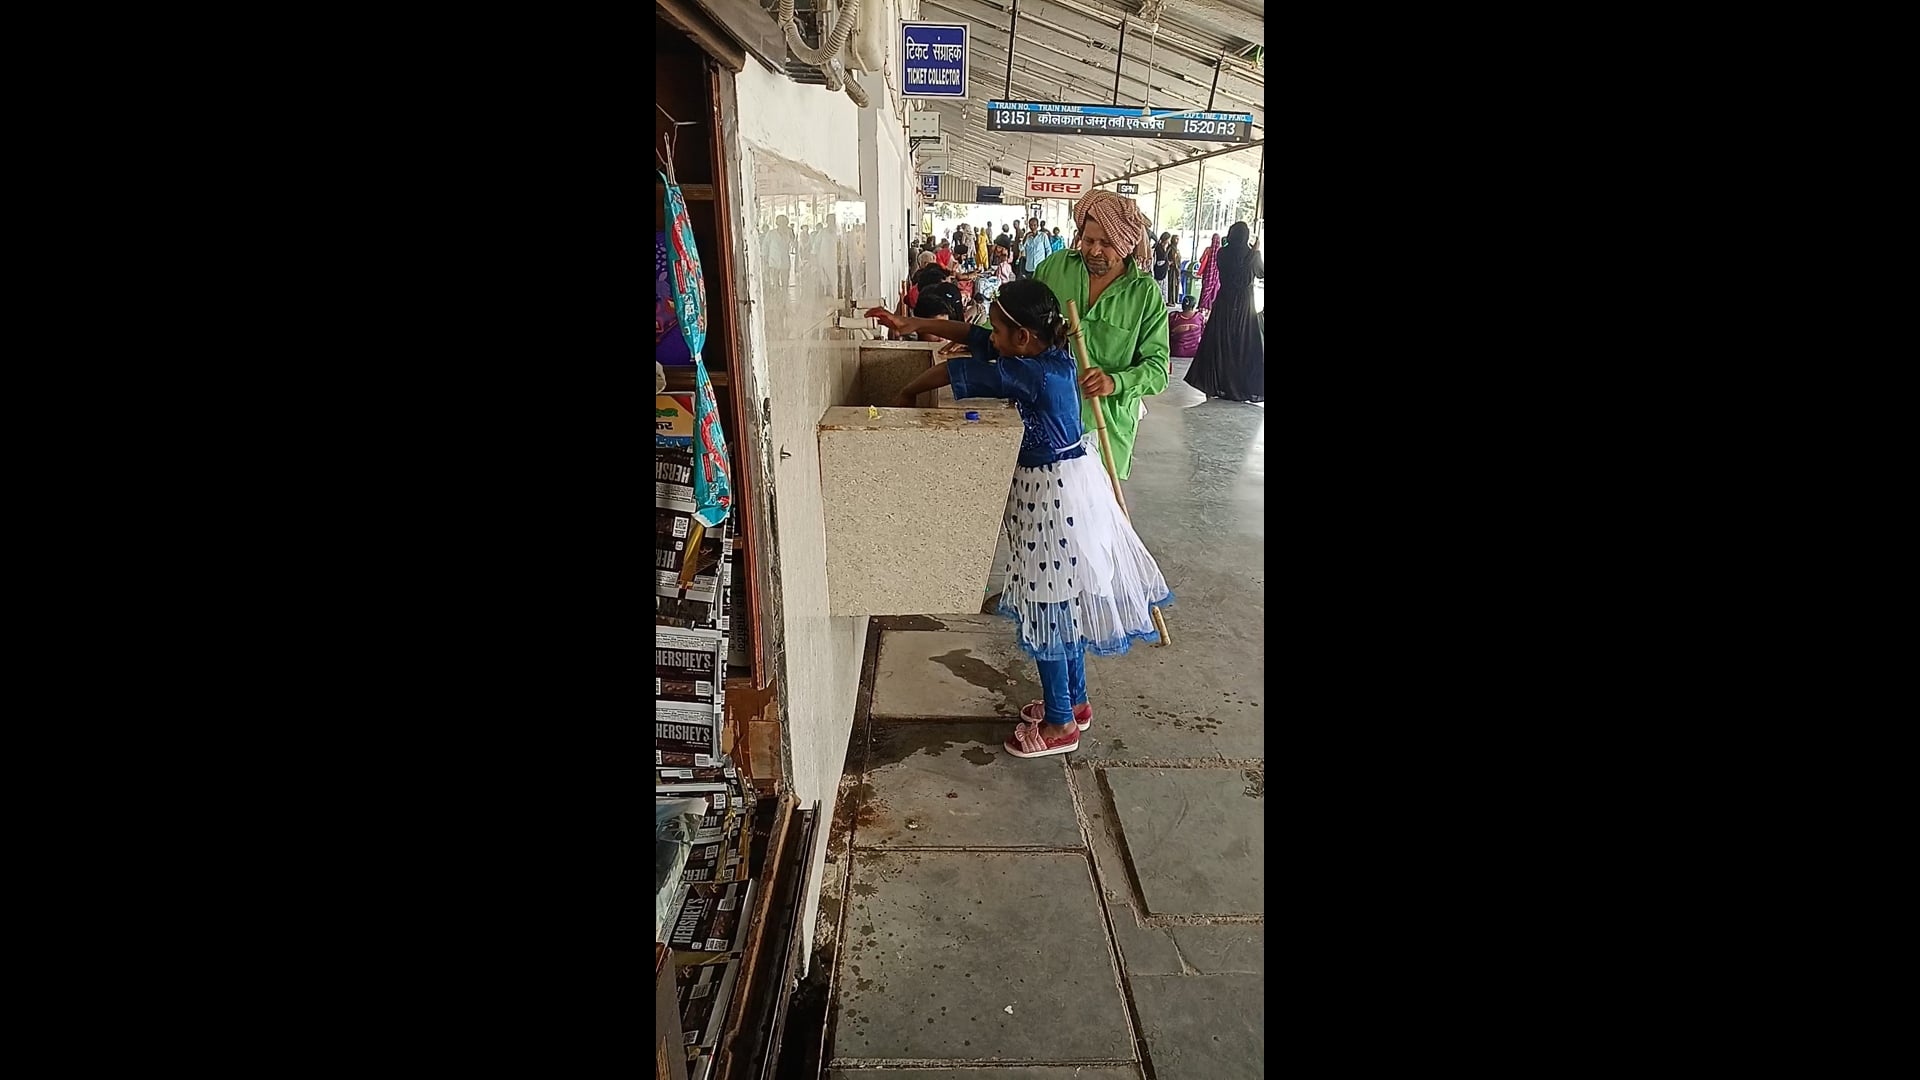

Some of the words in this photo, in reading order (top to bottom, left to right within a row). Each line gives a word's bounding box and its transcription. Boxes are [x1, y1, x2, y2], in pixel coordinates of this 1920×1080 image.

[906, 36, 929, 60] टिकट
[932, 36, 962, 63] संग्राहक
[907, 67, 927, 85] TICKET
[928, 68, 960, 85] COLLECTOR
[995, 101, 1016, 110] TRAIN
[1018, 103, 1030, 111] NO.
[1039, 104, 1060, 112] TRAIN
[996, 110, 1031, 125] 13151
[1038, 111, 1083, 126] कोलकाता
[1085, 116, 1107, 129] जम्मू
[1108, 115, 1125, 128] तवी
[1184, 119, 1215, 134] 15:20
[1032, 166, 1083, 178] EXIT
[1031, 181, 1082, 193] बाहर
[656, 722, 710, 742] HERSHEY'S
[672, 898, 705, 944] HERSHEY'S
